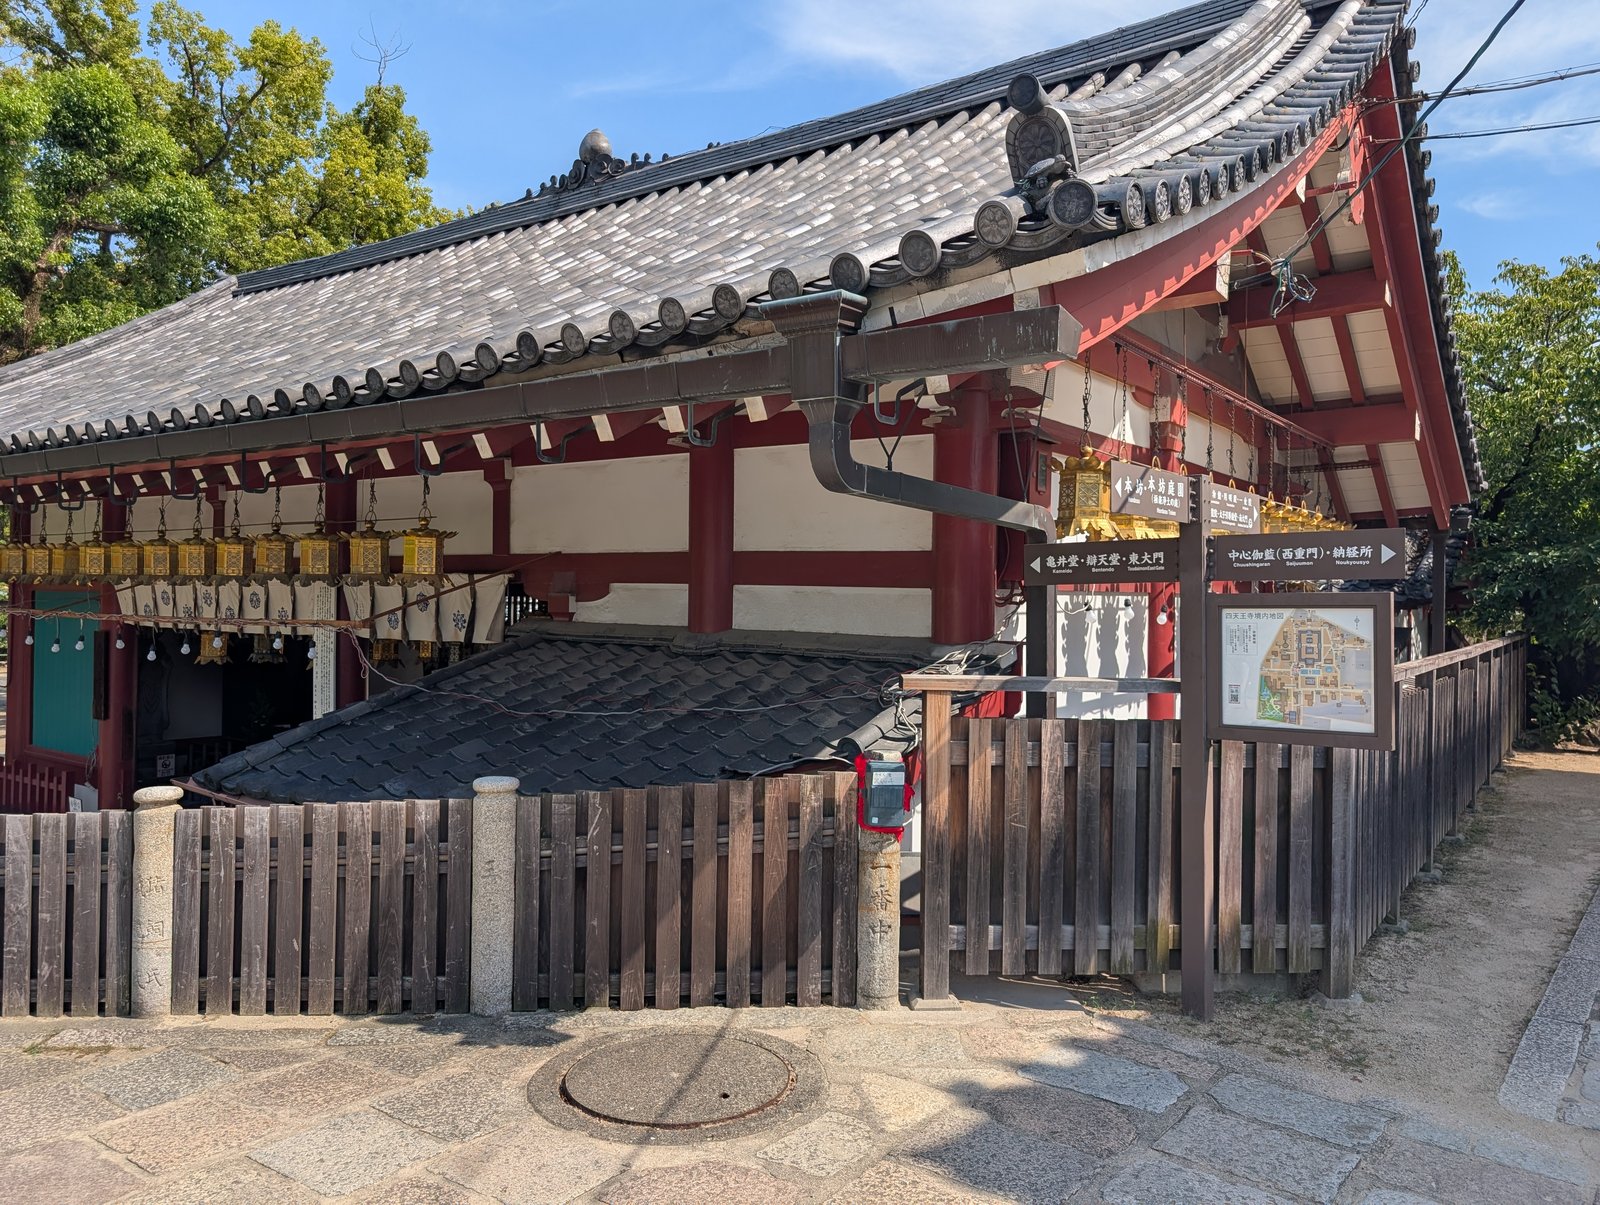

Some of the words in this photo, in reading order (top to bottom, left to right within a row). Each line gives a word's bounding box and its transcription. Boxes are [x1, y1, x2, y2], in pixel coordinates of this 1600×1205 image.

[1225, 612, 1284, 620] 四天王寺境内地図
